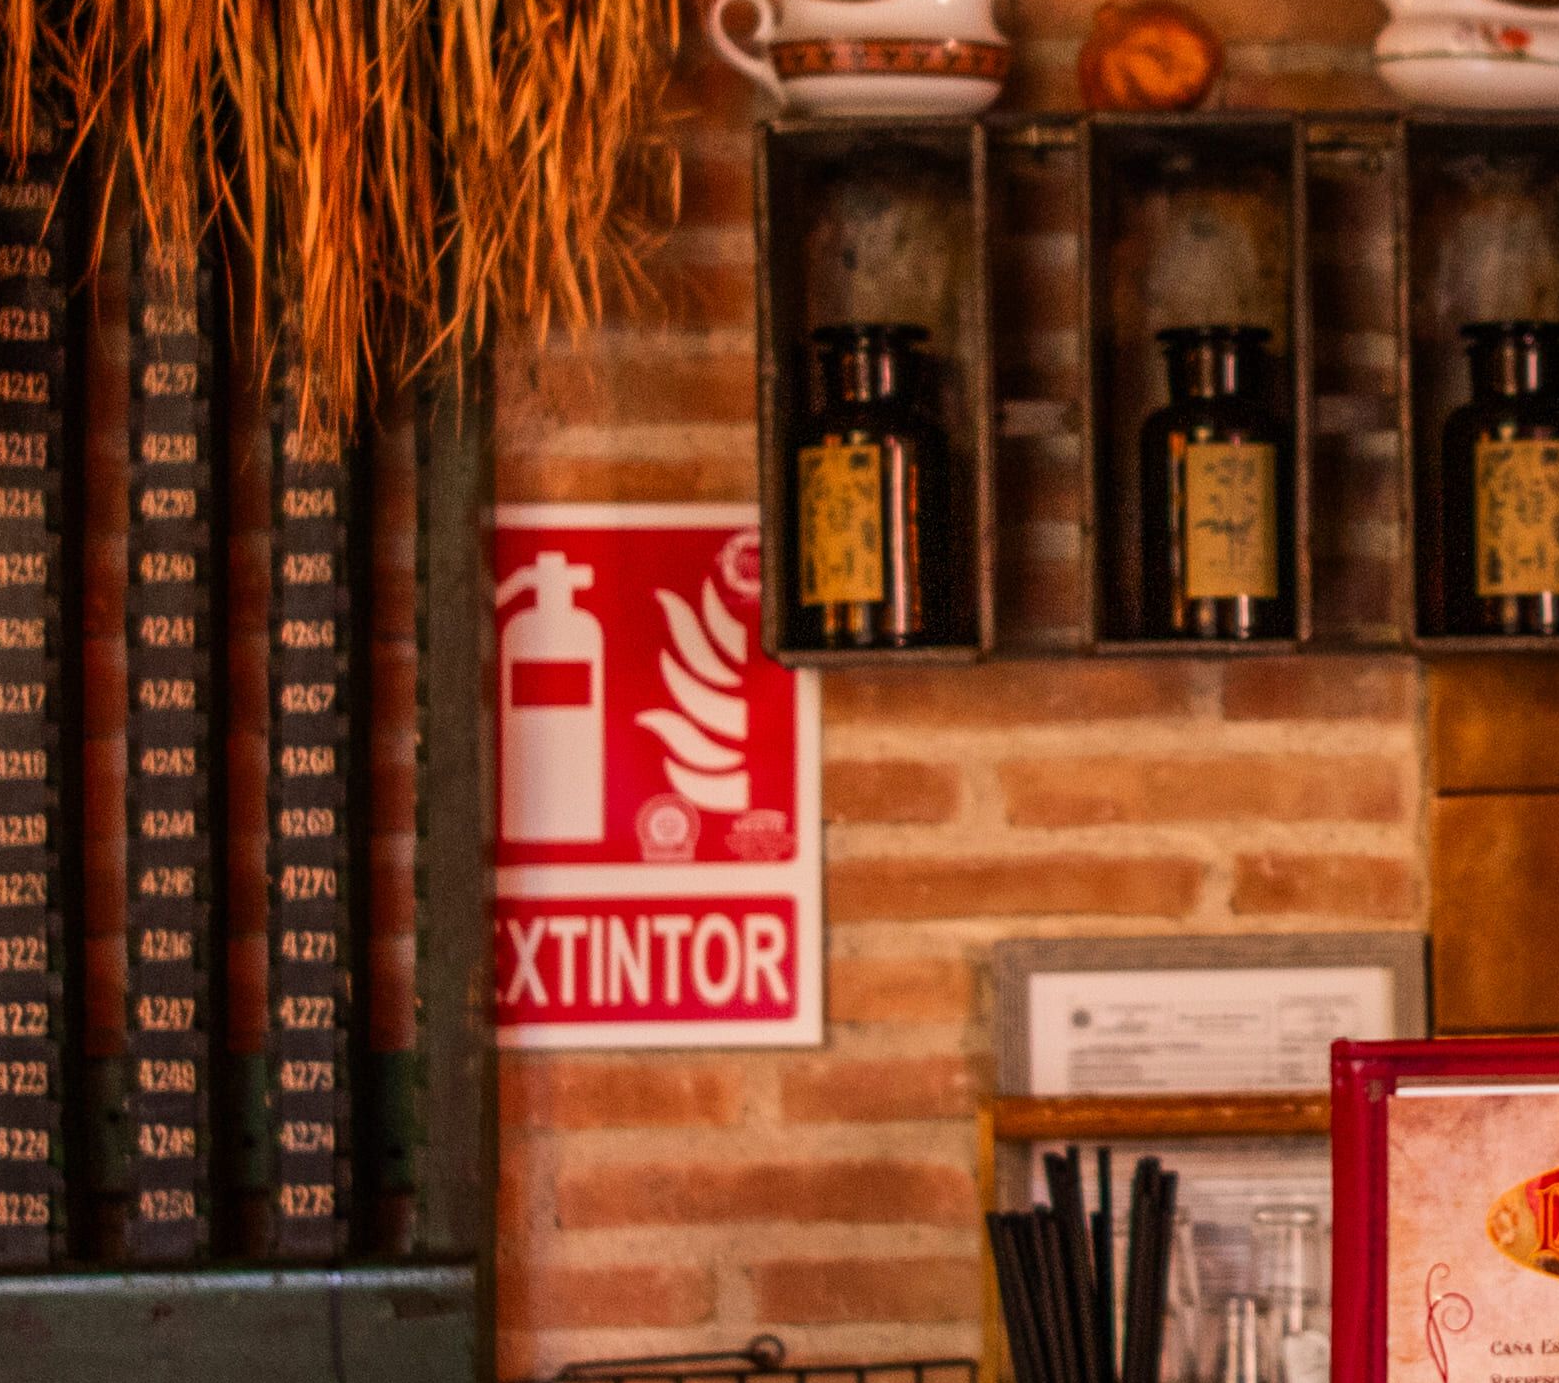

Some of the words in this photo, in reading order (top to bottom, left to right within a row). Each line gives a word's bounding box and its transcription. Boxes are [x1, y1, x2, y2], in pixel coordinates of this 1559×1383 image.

[142, 362, 198, 397] 4237
[142, 432, 197, 463] 4238
[140, 488, 196, 519] 4239
[282, 489, 336, 519] 4264
[140, 552, 196, 582] 4240
[141, 615, 196, 647] 4241
[280, 620, 335, 649] 4266
[139, 679, 196, 709] 4242
[281, 682, 336, 713] 4267
[141, 747, 196, 776] 4243
[141, 810, 196, 838] 4244
[279, 808, 336, 838] 4269
[280, 866, 336, 899] 4270
[282, 931, 337, 961] 4271
[495, 914, 790, 1006] XTINTOR
[137, 996, 196, 1031] 4247
[279, 996, 335, 1030] 4272
[139, 1059, 196, 1092] 4248
[280, 1060, 334, 1091] 4273
[139, 1124, 195, 1158] 4249
[280, 1184, 334, 1217] 4275
